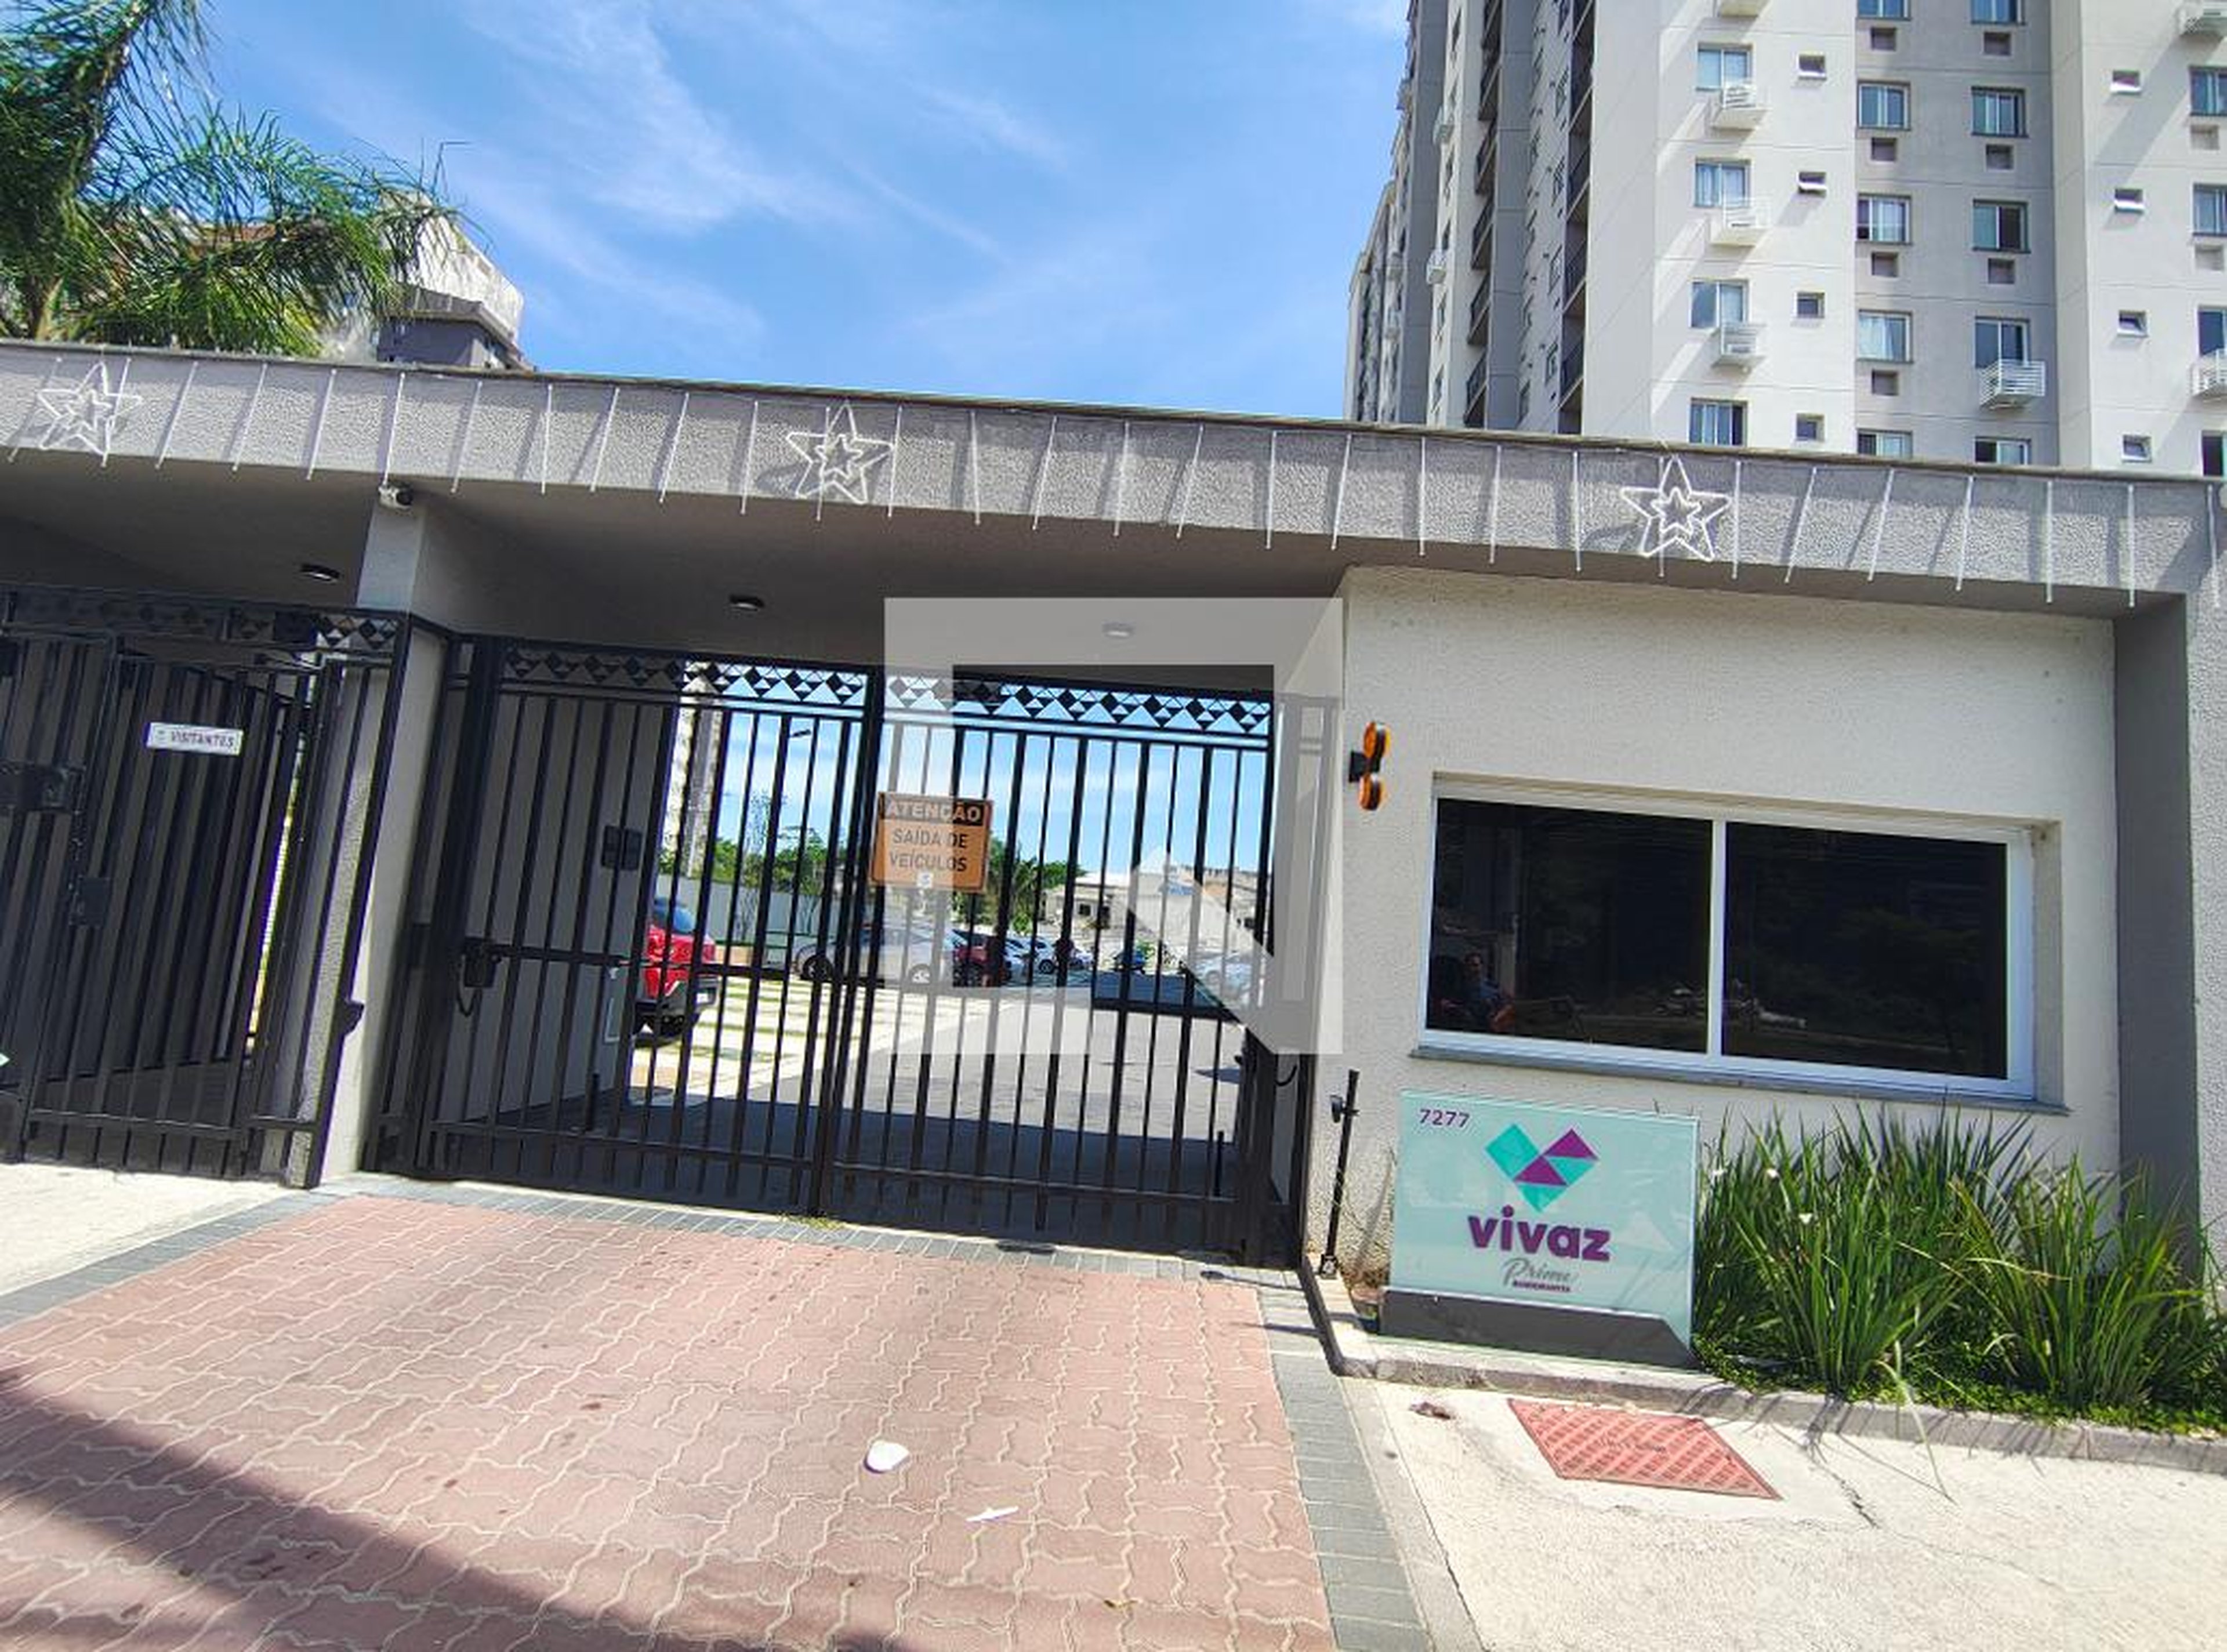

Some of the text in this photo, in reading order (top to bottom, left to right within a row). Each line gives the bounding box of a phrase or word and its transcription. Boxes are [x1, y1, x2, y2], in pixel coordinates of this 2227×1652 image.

[171, 730, 234, 749] VISITANTES
[886, 801, 981, 823] ATENÇÃO
[893, 826, 969, 848] SAÍDA DE
[890, 849, 967, 872] VEÍCULOS
[1419, 1109, 1470, 1128] 7277
[1467, 1204, 1611, 1261] vivaz
